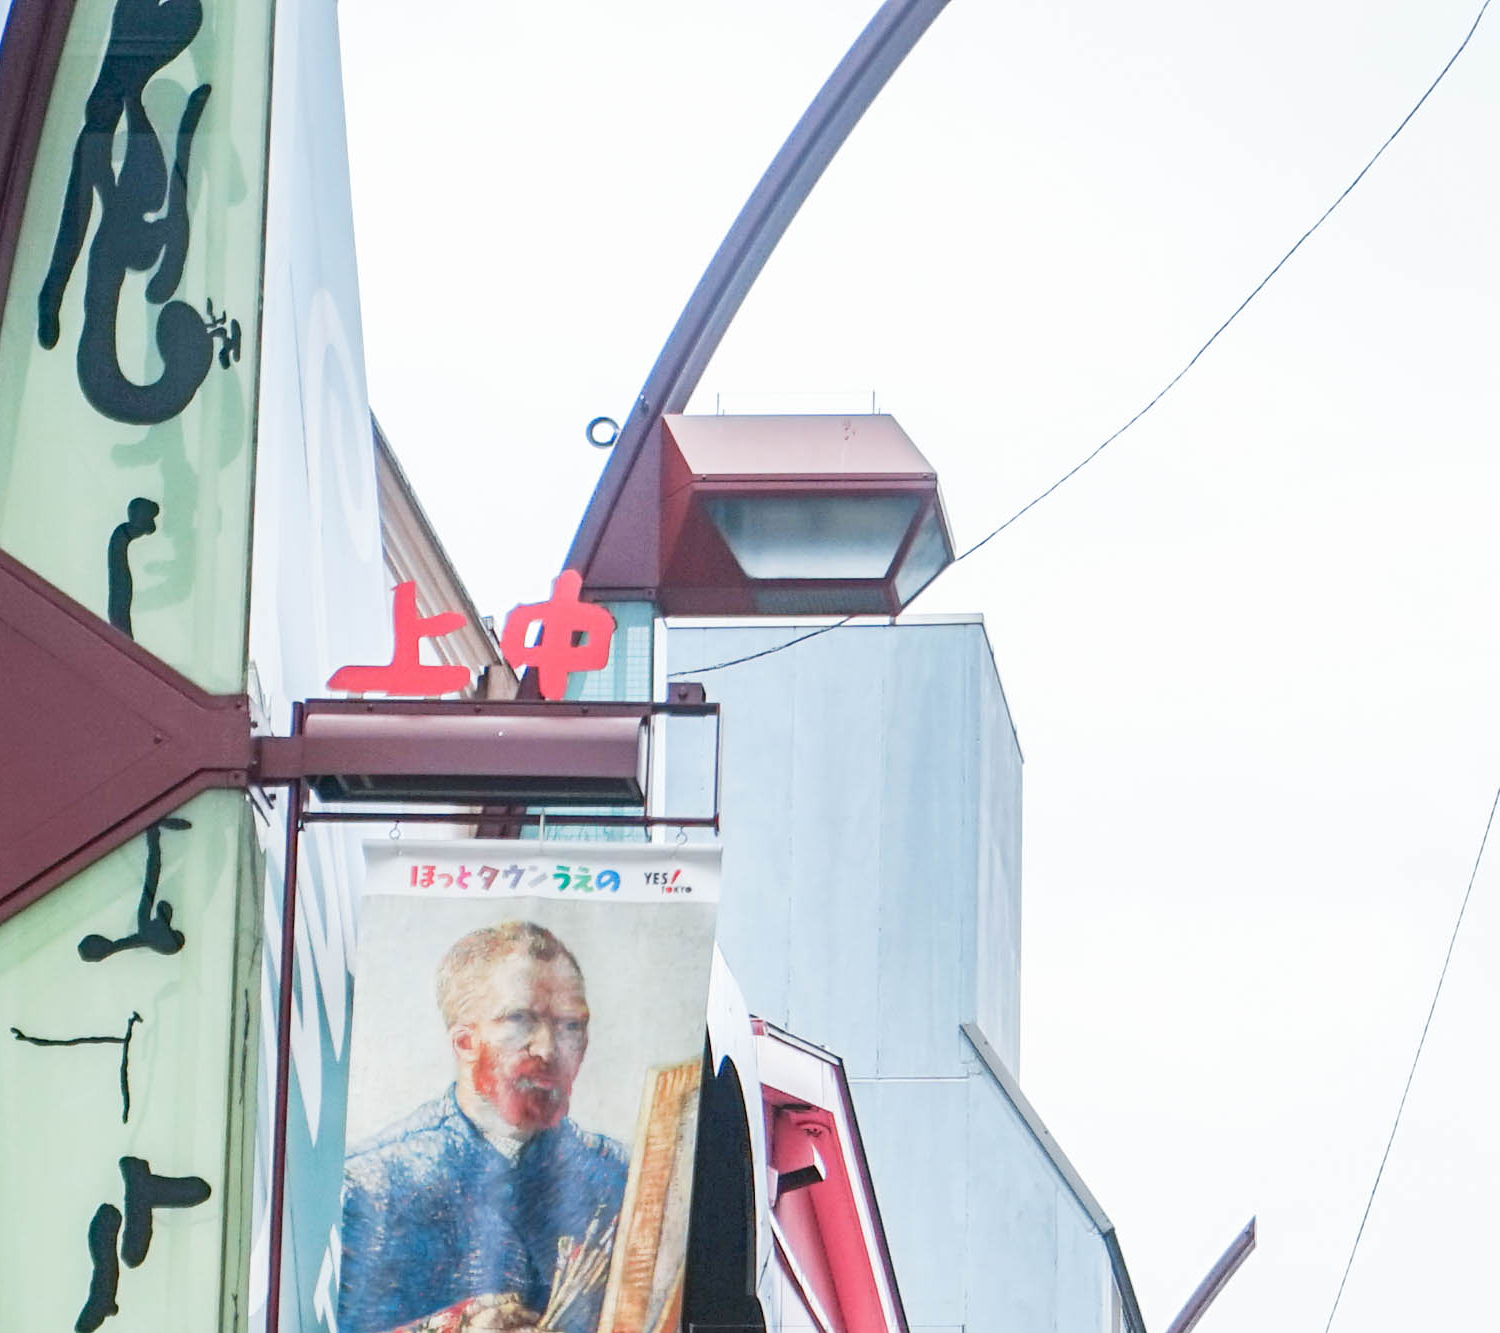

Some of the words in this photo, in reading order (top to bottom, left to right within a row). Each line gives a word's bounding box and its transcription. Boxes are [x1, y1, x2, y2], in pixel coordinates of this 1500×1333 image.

[410, 864, 621, 893] ほっとタウンうえの
[644, 869, 682, 886] YES!
